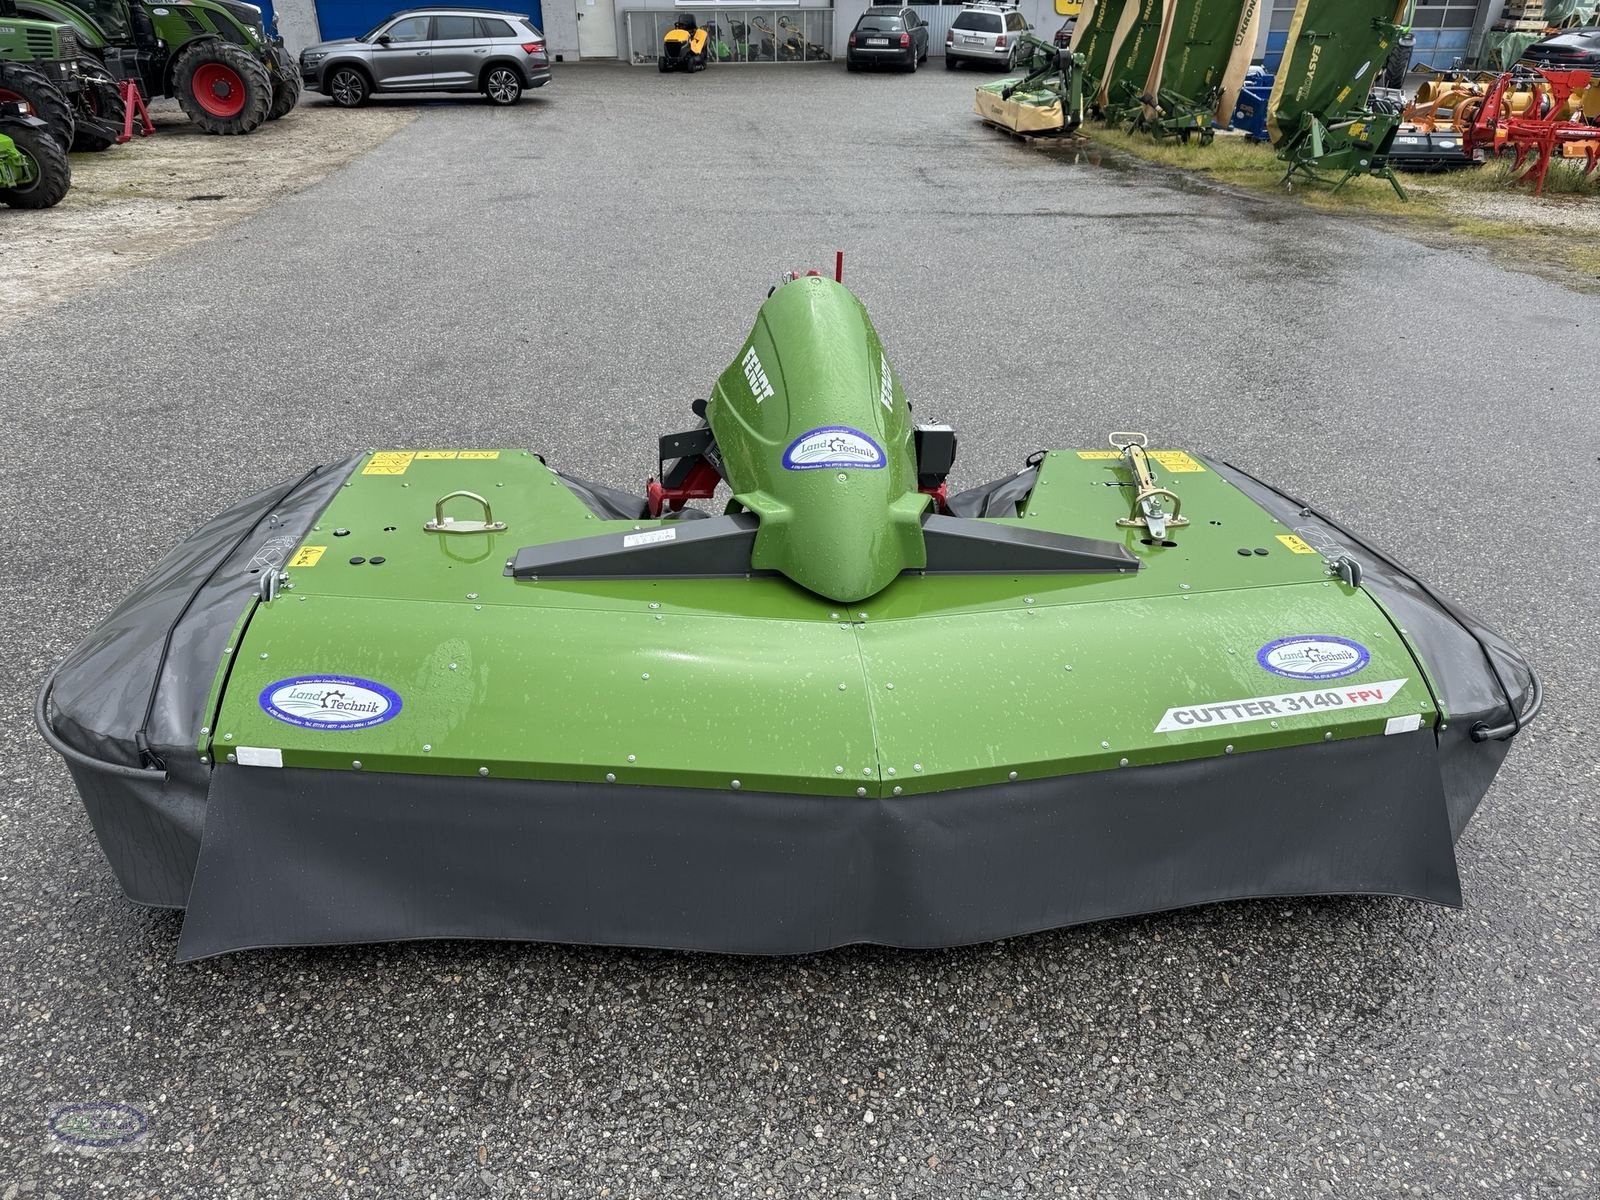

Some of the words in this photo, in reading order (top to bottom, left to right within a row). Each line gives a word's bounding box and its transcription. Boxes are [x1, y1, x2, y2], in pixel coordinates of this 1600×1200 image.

[1240, 0, 1258, 34] KRON
[741, 345, 775, 404] FENDT
[801, 440, 827, 453] Land
[836, 444, 875, 459] Technik
[1278, 650, 1304, 660] Land
[1315, 650, 1355, 662] Technik
[288, 688, 324, 701] Land
[330, 700, 379, 713] Technik
[1172, 699, 1279, 725] CUTTER
[1281, 691, 1344, 713] 3140
[1345, 688, 1384, 703] FPV
